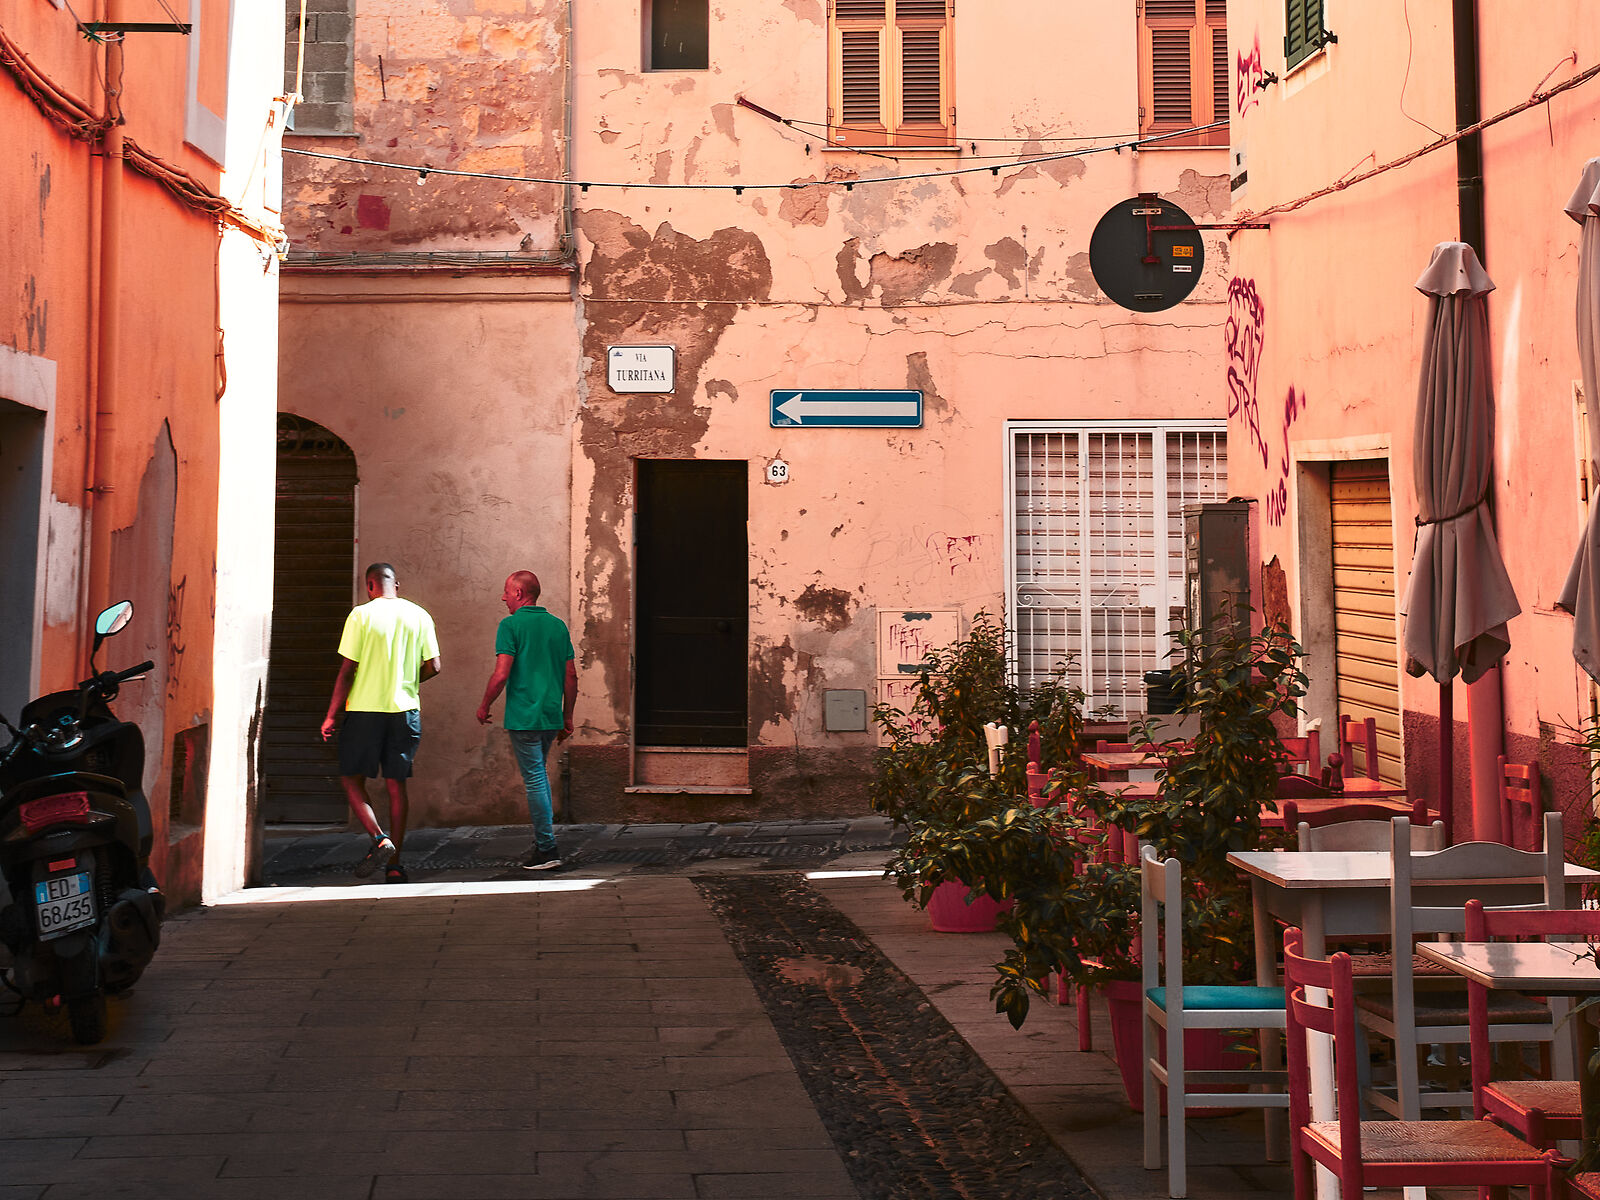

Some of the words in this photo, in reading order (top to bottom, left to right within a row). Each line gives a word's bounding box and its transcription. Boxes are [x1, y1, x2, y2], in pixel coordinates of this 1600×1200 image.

[635, 353, 647, 362] VIA
[616, 369, 666, 381] TURRITANA
[772, 465, 786, 477] 63
[49, 879, 70, 900] ED
[41, 897, 91, 927] 68435
